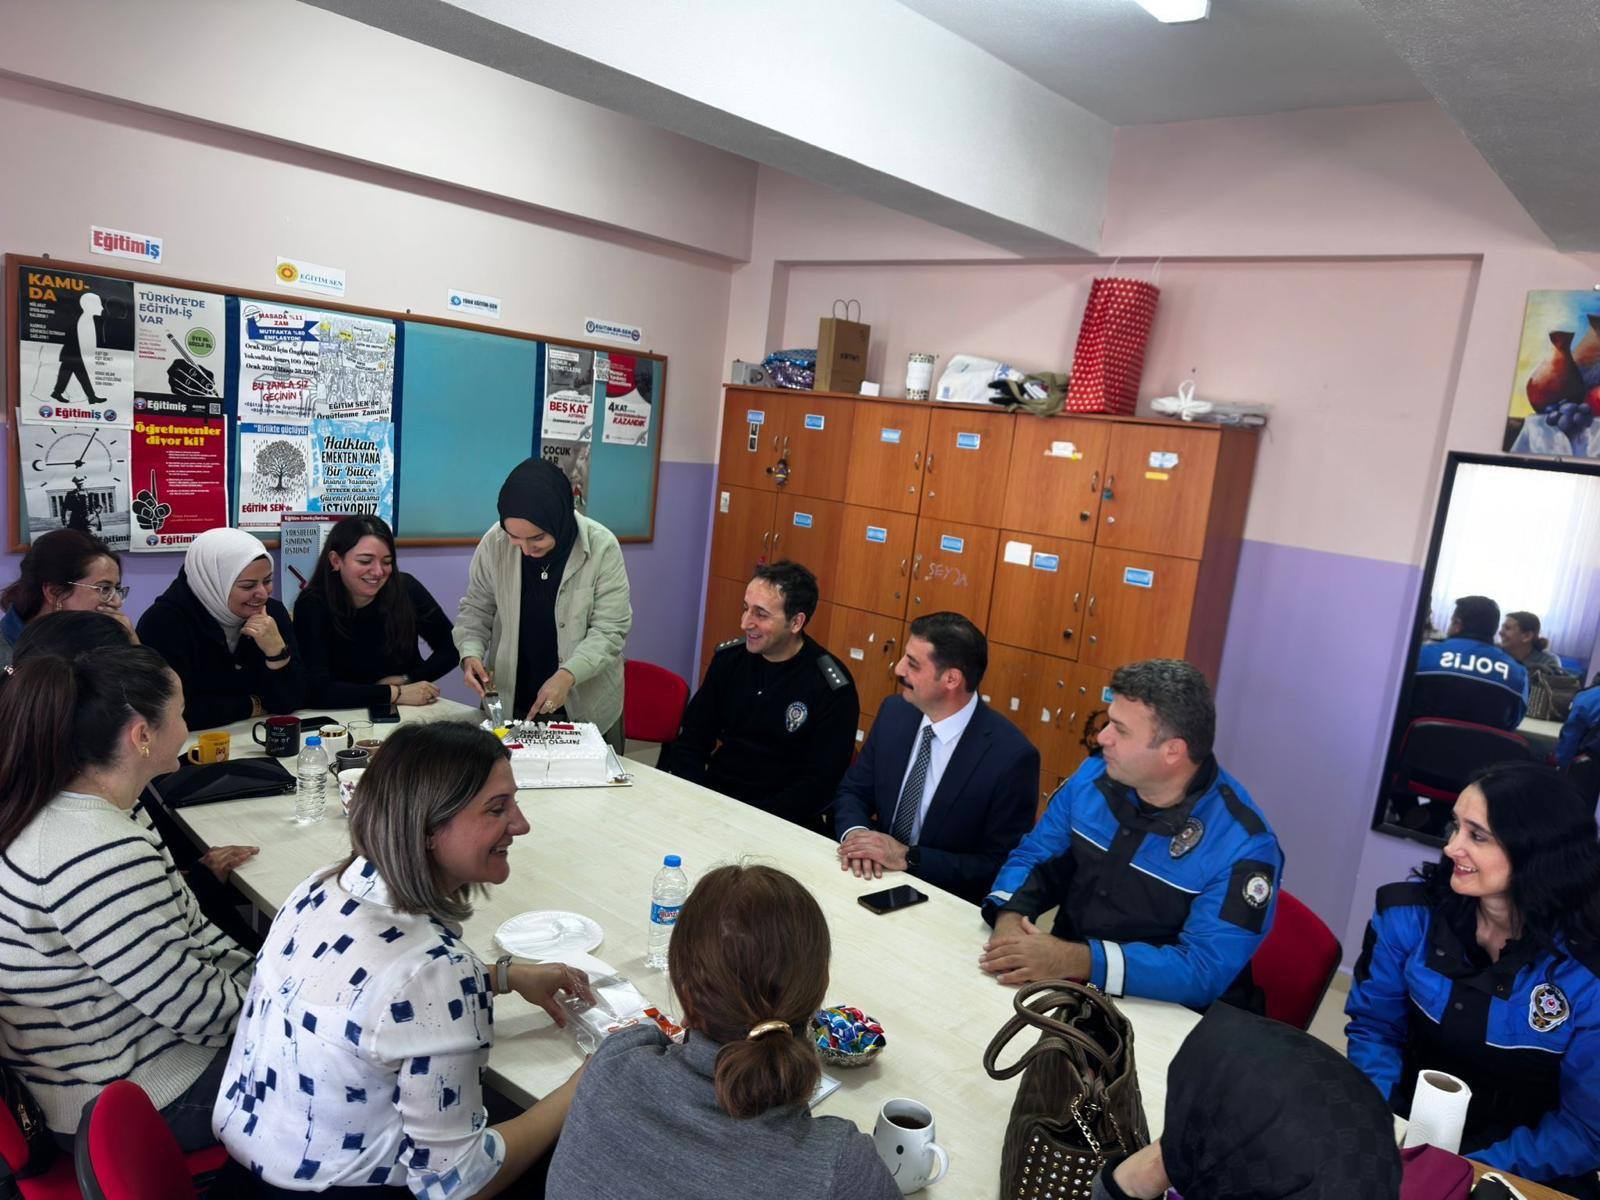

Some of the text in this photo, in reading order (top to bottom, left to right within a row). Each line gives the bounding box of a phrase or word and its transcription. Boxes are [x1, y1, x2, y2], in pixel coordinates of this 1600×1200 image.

[93, 230, 160, 259] Eğitimiş
[28, 272, 90, 291] KAMU-
[28, 286, 57, 302] DA
[139, 291, 206, 309] TÜRKİYE'DE
[139, 302, 193, 320] EĞİTİM-İŞ
[139, 314, 164, 325] VAR
[147, 400, 187, 413] Eğitimiş
[328, 402, 354, 410] EĞİTİM
[549, 401, 588, 414] BEŞ KAT
[55, 407, 102, 420] Eğitimiş
[323, 436, 378, 452] Halktan,
[321, 451, 381, 465] EMEKTEN YANA
[325, 465, 342, 477] Bir
[241, 503, 268, 513] EĞİTİM
